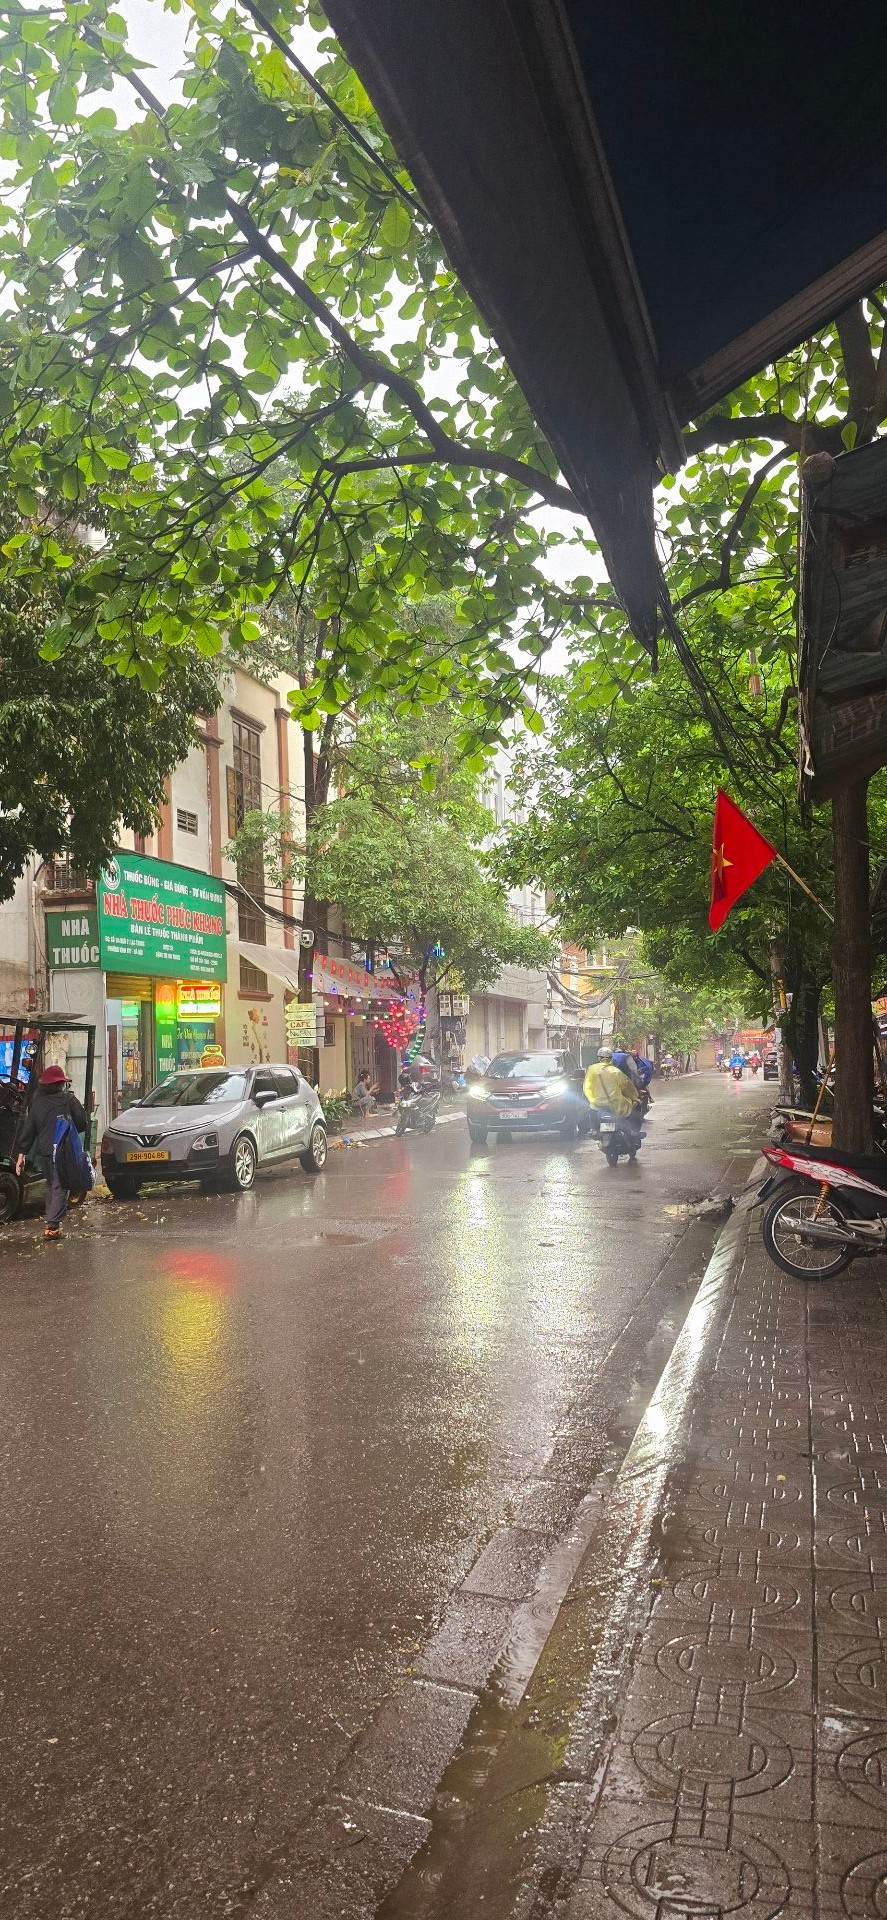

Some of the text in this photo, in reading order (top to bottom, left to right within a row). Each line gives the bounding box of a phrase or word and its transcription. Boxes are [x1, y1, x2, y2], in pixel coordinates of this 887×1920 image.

[123, 869, 143, 884] THUỐC
[164, 879, 174, 892] GIÁ
[102, 888, 223, 936] NHÀ THUỐC PHÚC KHANG
[61, 916, 90, 937] NHÀ
[152, 926, 170, 939] THUỐC
[52, 940, 100, 965] THUỐC
